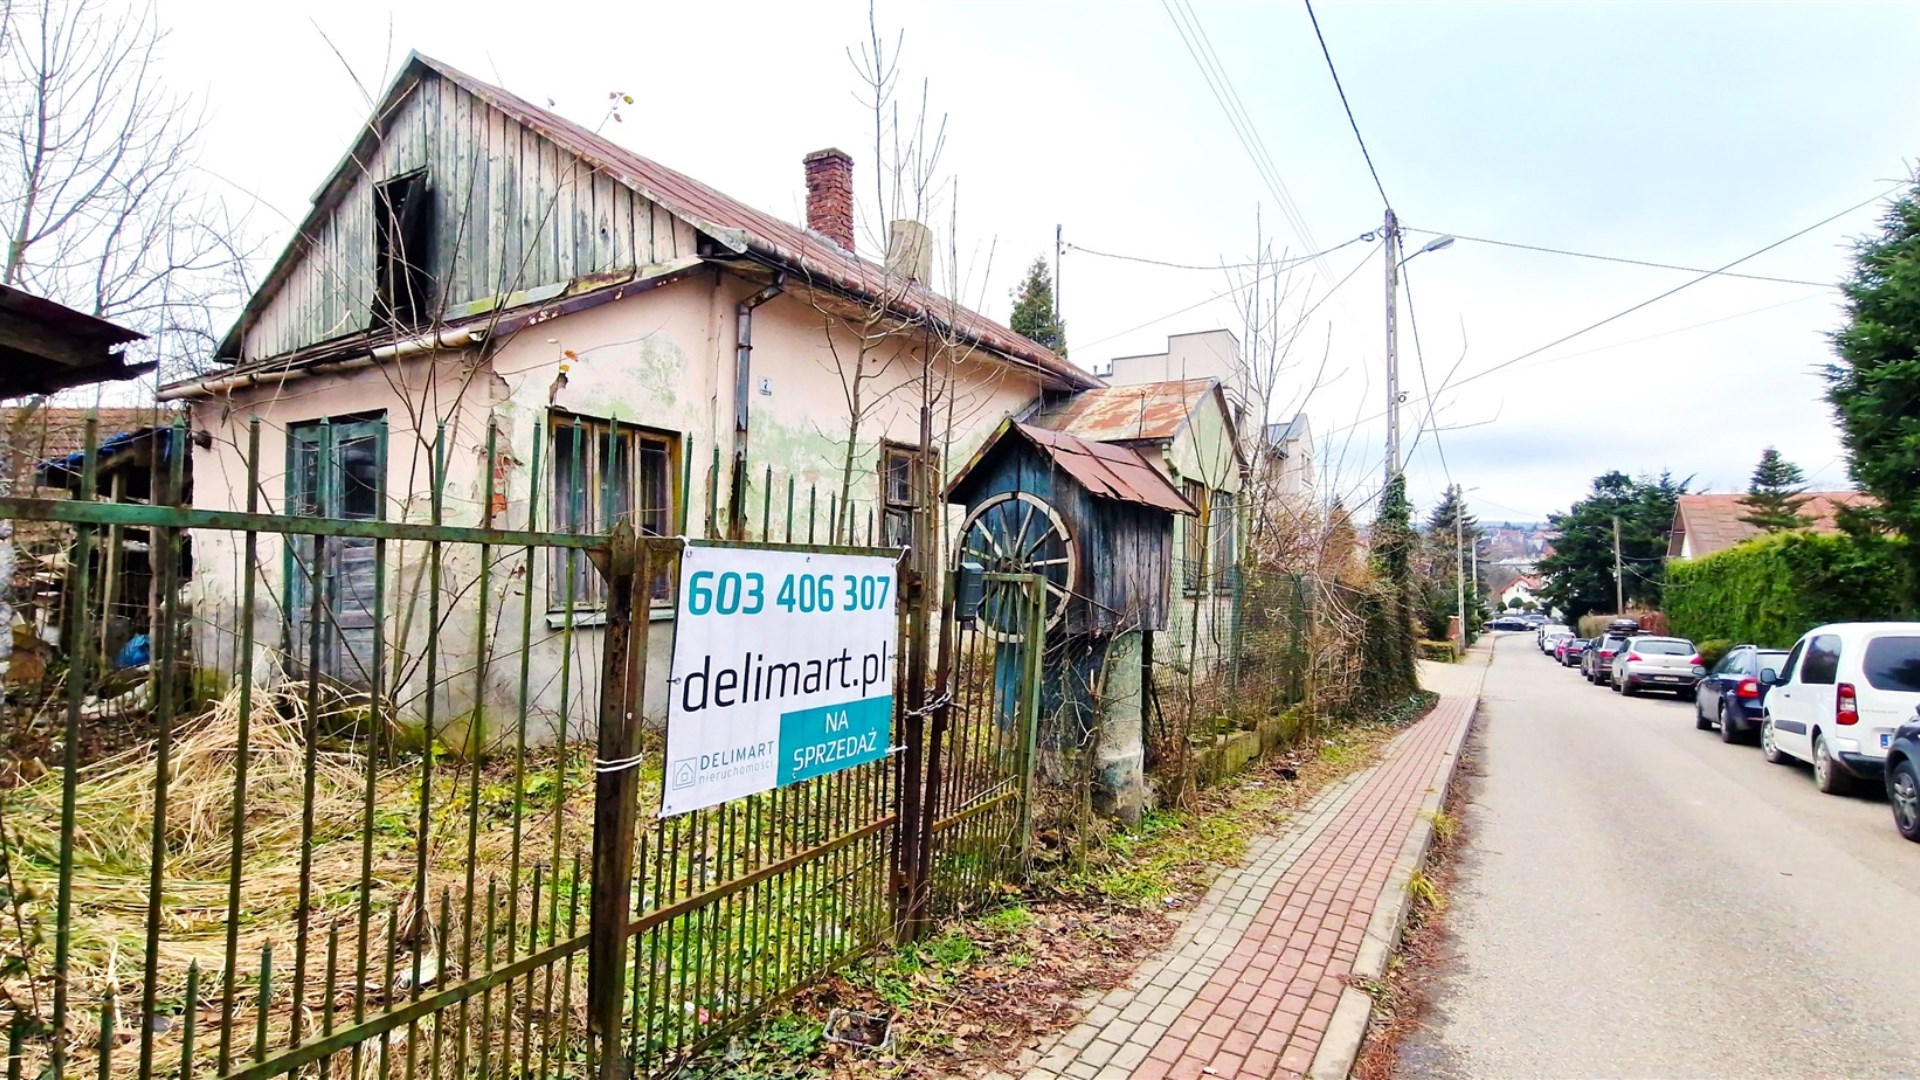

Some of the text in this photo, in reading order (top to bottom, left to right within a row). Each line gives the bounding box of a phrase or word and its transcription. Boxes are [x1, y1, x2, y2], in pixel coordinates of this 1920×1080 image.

[688, 571, 890, 616] 603 406 307
[682, 640, 887, 713] delimart.pl
[825, 710, 849, 734] NA
[700, 741, 774, 771] DELIMART
[792, 727, 877, 771] SPRZEDAŻ
[698, 760, 774, 785] nieruchomości
